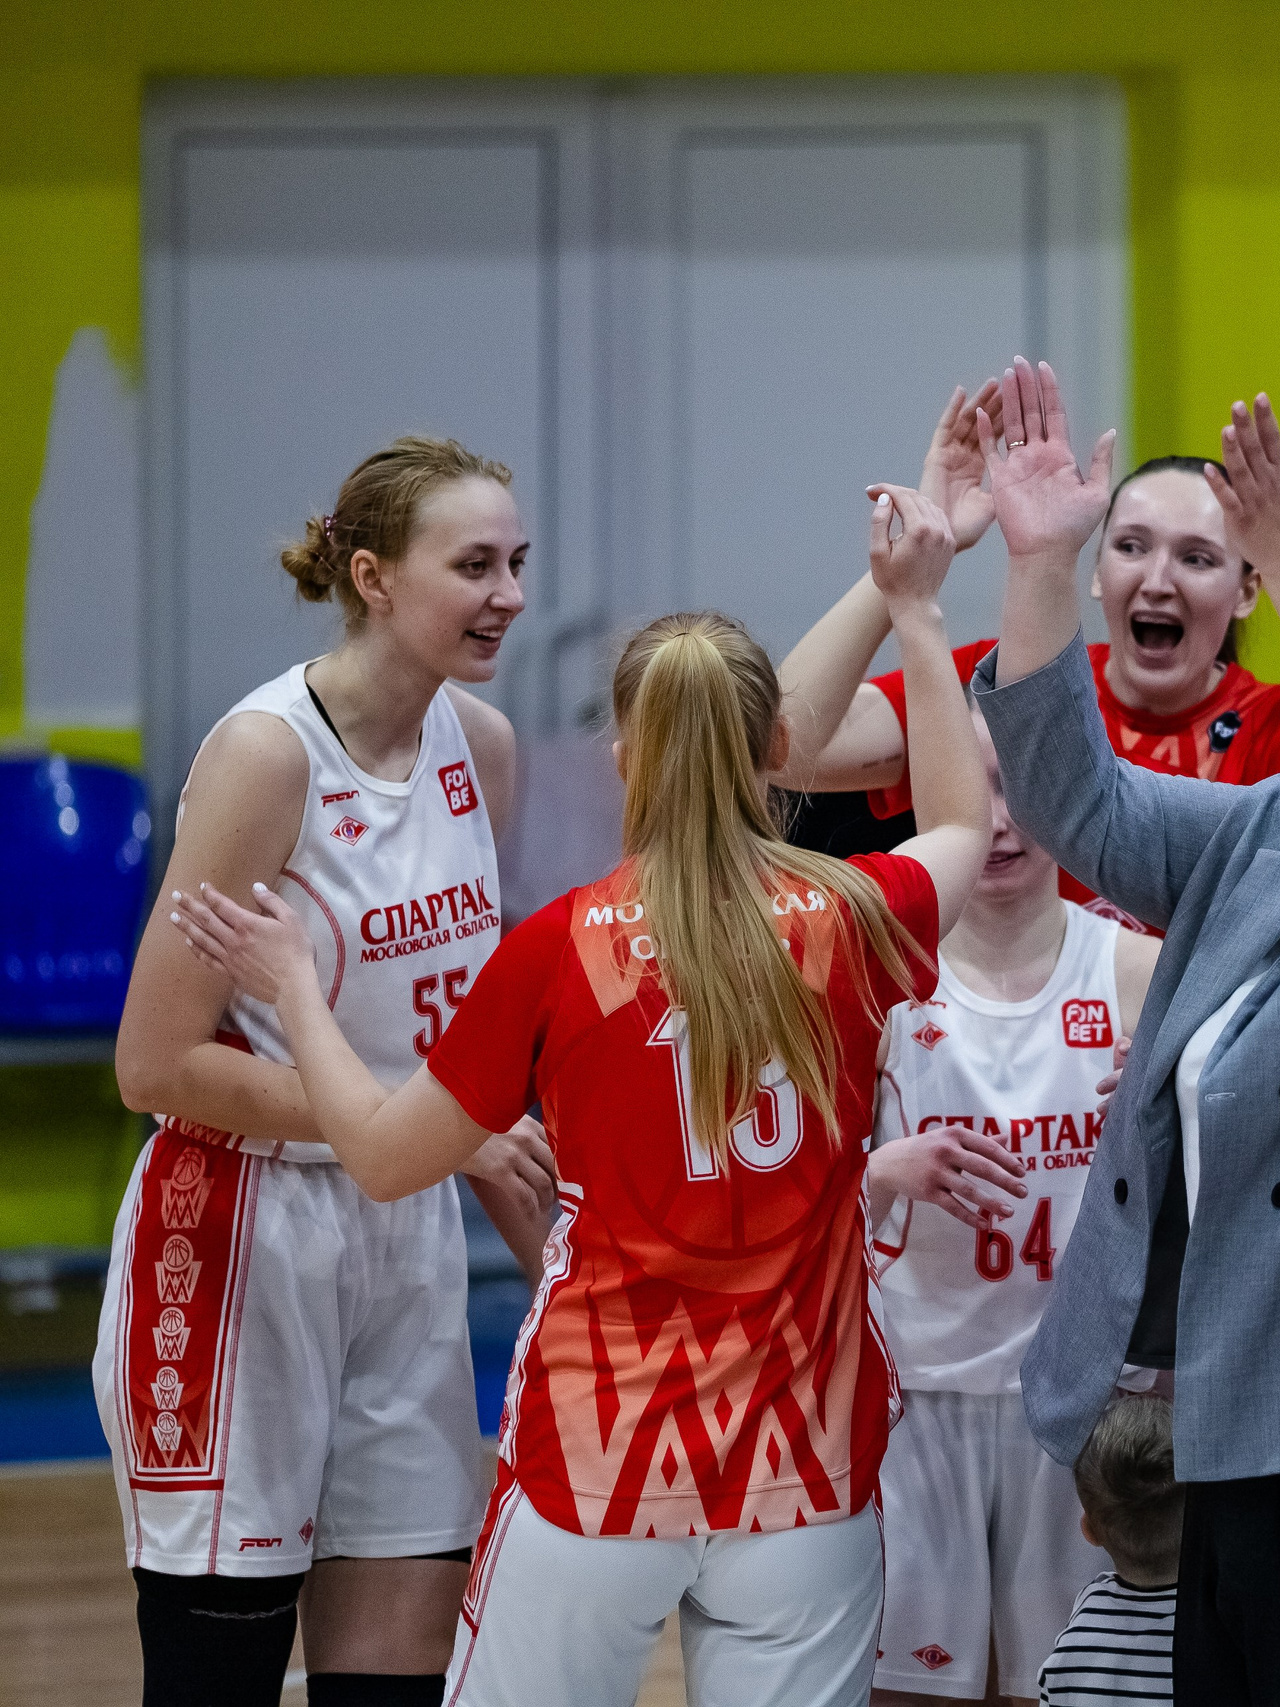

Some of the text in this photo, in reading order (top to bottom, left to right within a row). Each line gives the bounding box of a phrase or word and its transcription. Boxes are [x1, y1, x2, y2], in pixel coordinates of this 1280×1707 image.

[450, 786, 470, 810] BE
[360, 875, 495, 946] СПАРТАК
[360, 929, 451, 963] МОСКОВСКАЯ
[1043, 1151, 1095, 1171] ОБЛАС
[975, 1197, 1056, 1282] 64
